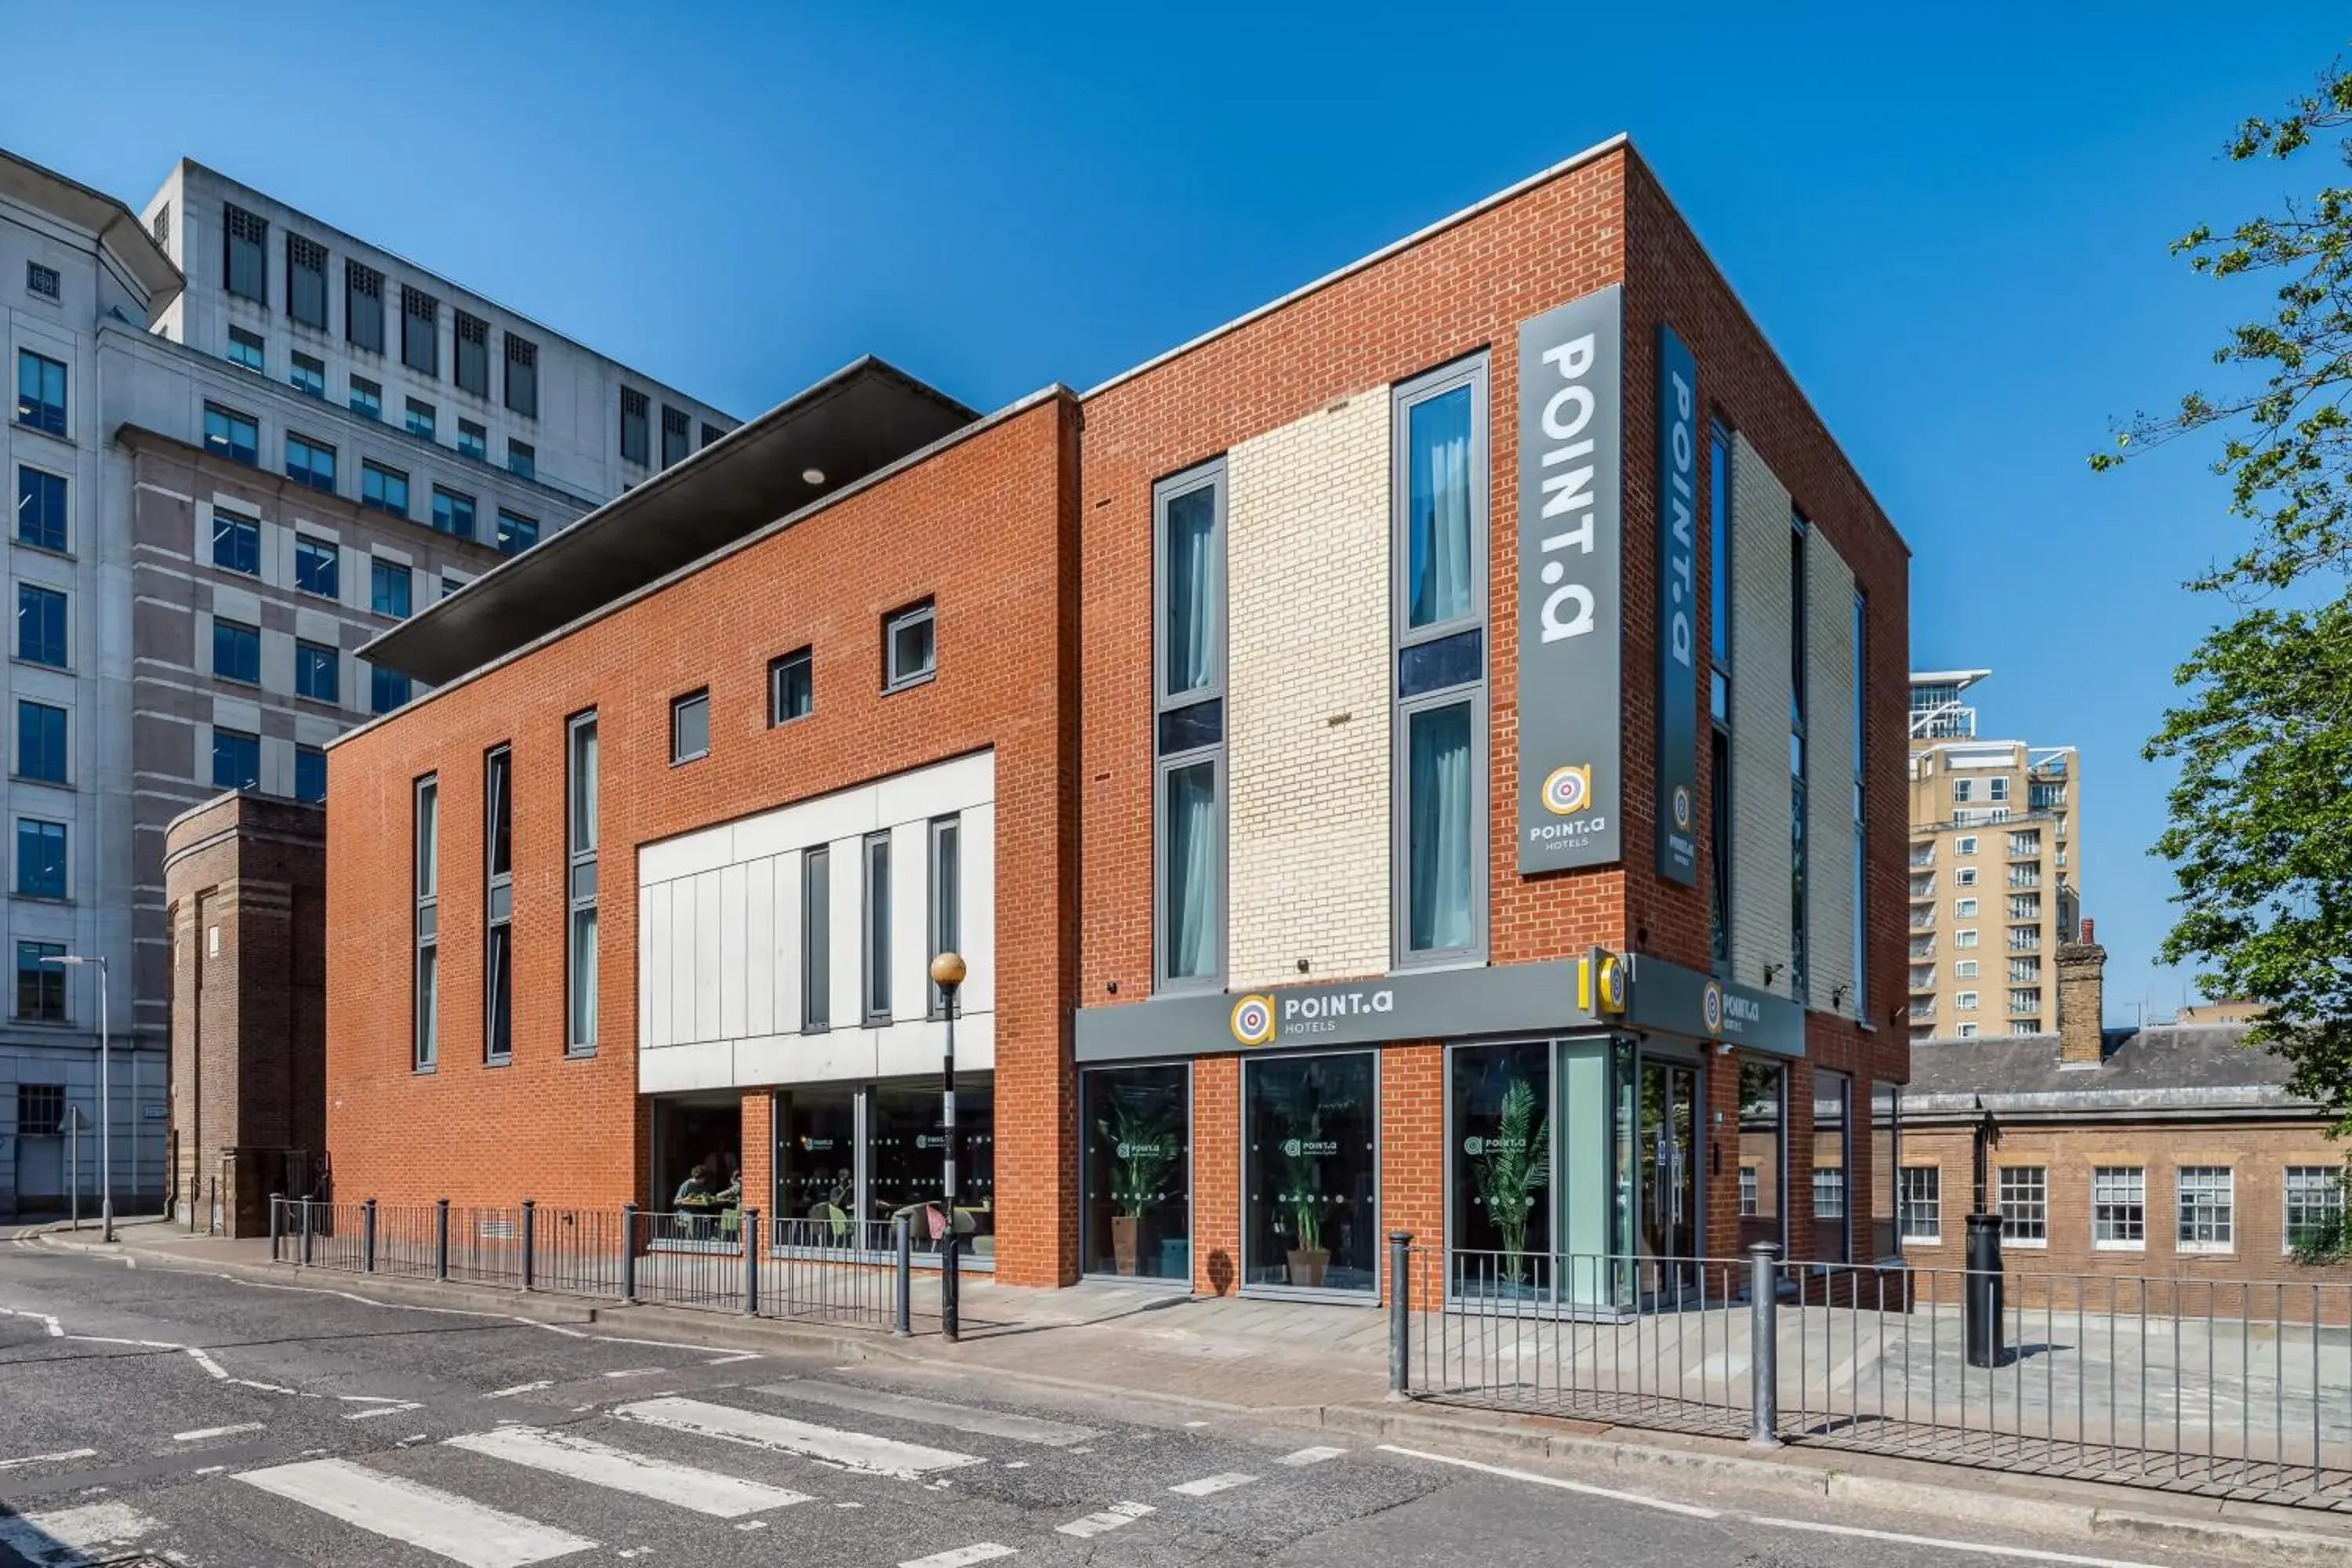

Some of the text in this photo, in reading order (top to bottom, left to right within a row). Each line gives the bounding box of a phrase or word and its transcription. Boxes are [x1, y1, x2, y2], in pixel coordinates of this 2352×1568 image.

[1541, 333, 1595, 644] POINT.a
[1672, 371, 1690, 667] POINT.a
[1530, 817, 1606, 841] POINT.a
[1545, 838, 1588, 851] HOTELS
[1285, 990, 1393, 1020] POINT.a
[1285, 1021, 1335, 1035] HOTELS
